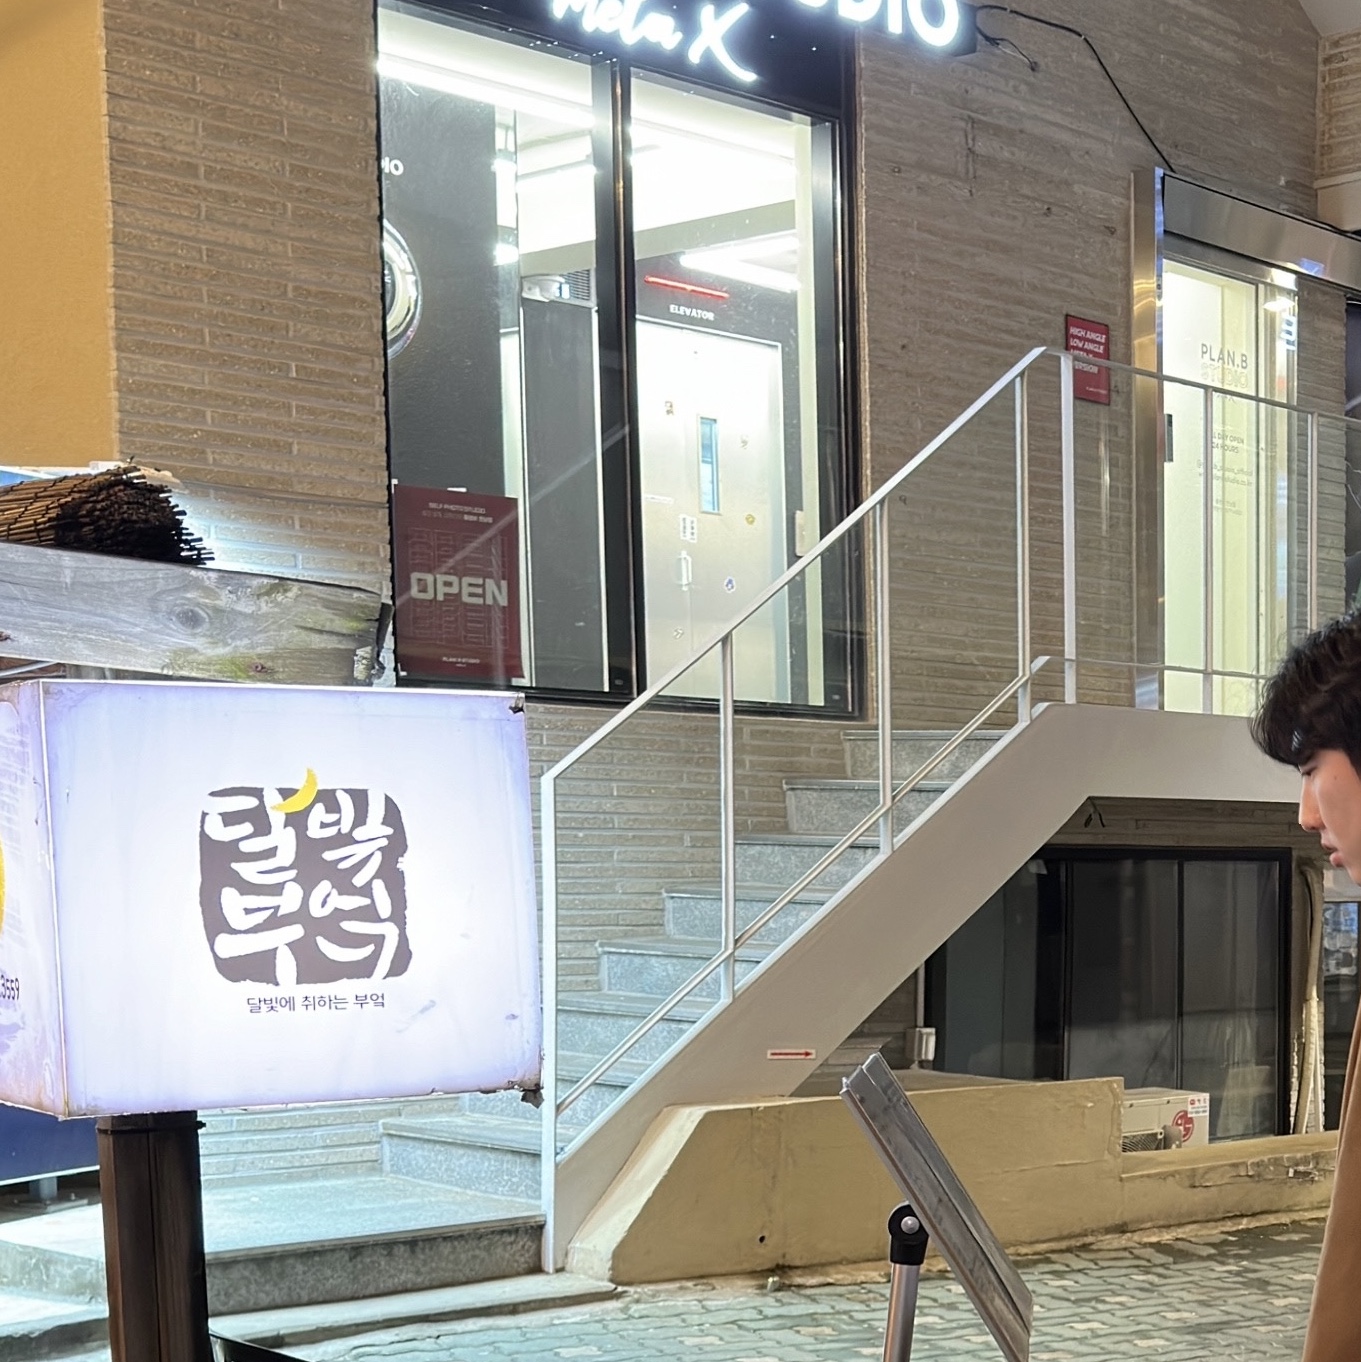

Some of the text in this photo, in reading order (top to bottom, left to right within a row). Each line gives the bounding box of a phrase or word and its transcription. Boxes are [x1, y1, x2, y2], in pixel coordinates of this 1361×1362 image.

[669, 304, 715, 321] ELEVATOR
[1201, 343, 1248, 370] PLAN.B
[410, 571, 509, 607] OPEN
[246, 995, 297, 1014] 달빛에
[300, 993, 349, 1012] 취하는
